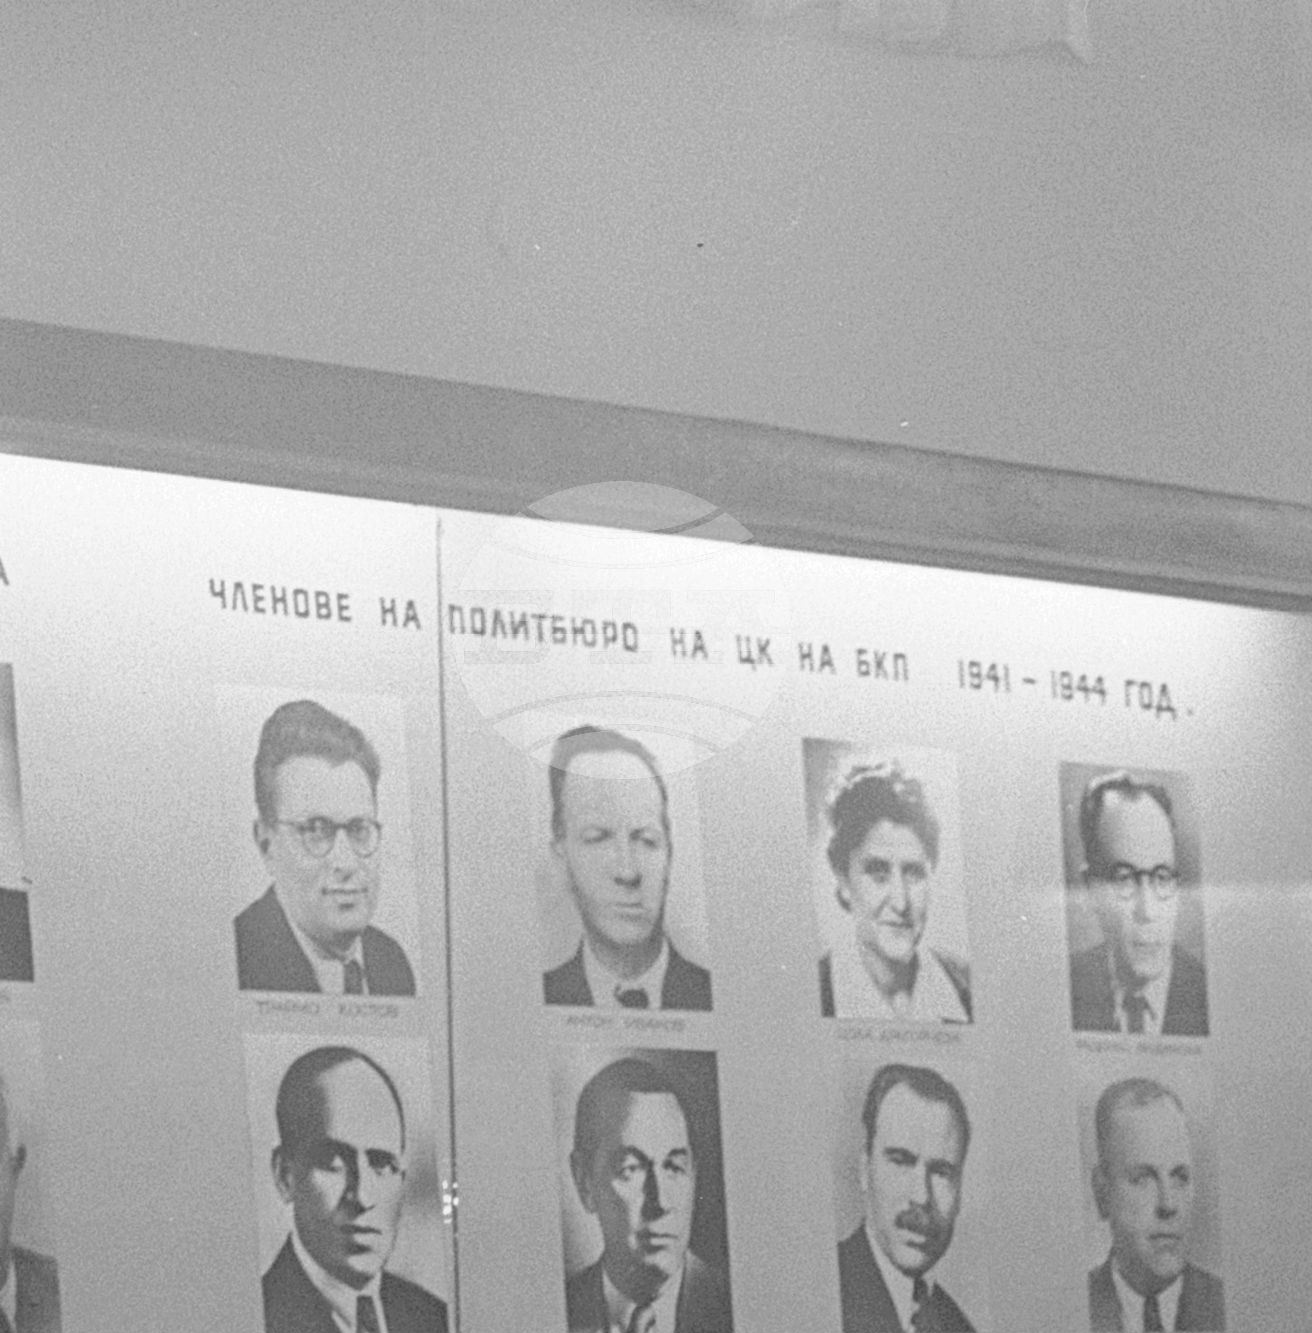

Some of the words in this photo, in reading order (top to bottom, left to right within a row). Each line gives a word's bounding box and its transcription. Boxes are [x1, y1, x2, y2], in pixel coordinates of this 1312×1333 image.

[209, 578, 353, 623] ЧЛЕНОВЕ
[379, 597, 422, 630] НА
[448, 604, 640, 653] ПОЛИТБЮРО
[669, 627, 709, 660] НА
[735, 634, 775, 673] ЦК
[798, 642, 837, 676] НА
[856, 647, 910, 683] БКП
[959, 659, 1012, 694] 1941
[1051, 669, 1107, 704] 1944
[1125, 678, 1195, 721] ГОД.
